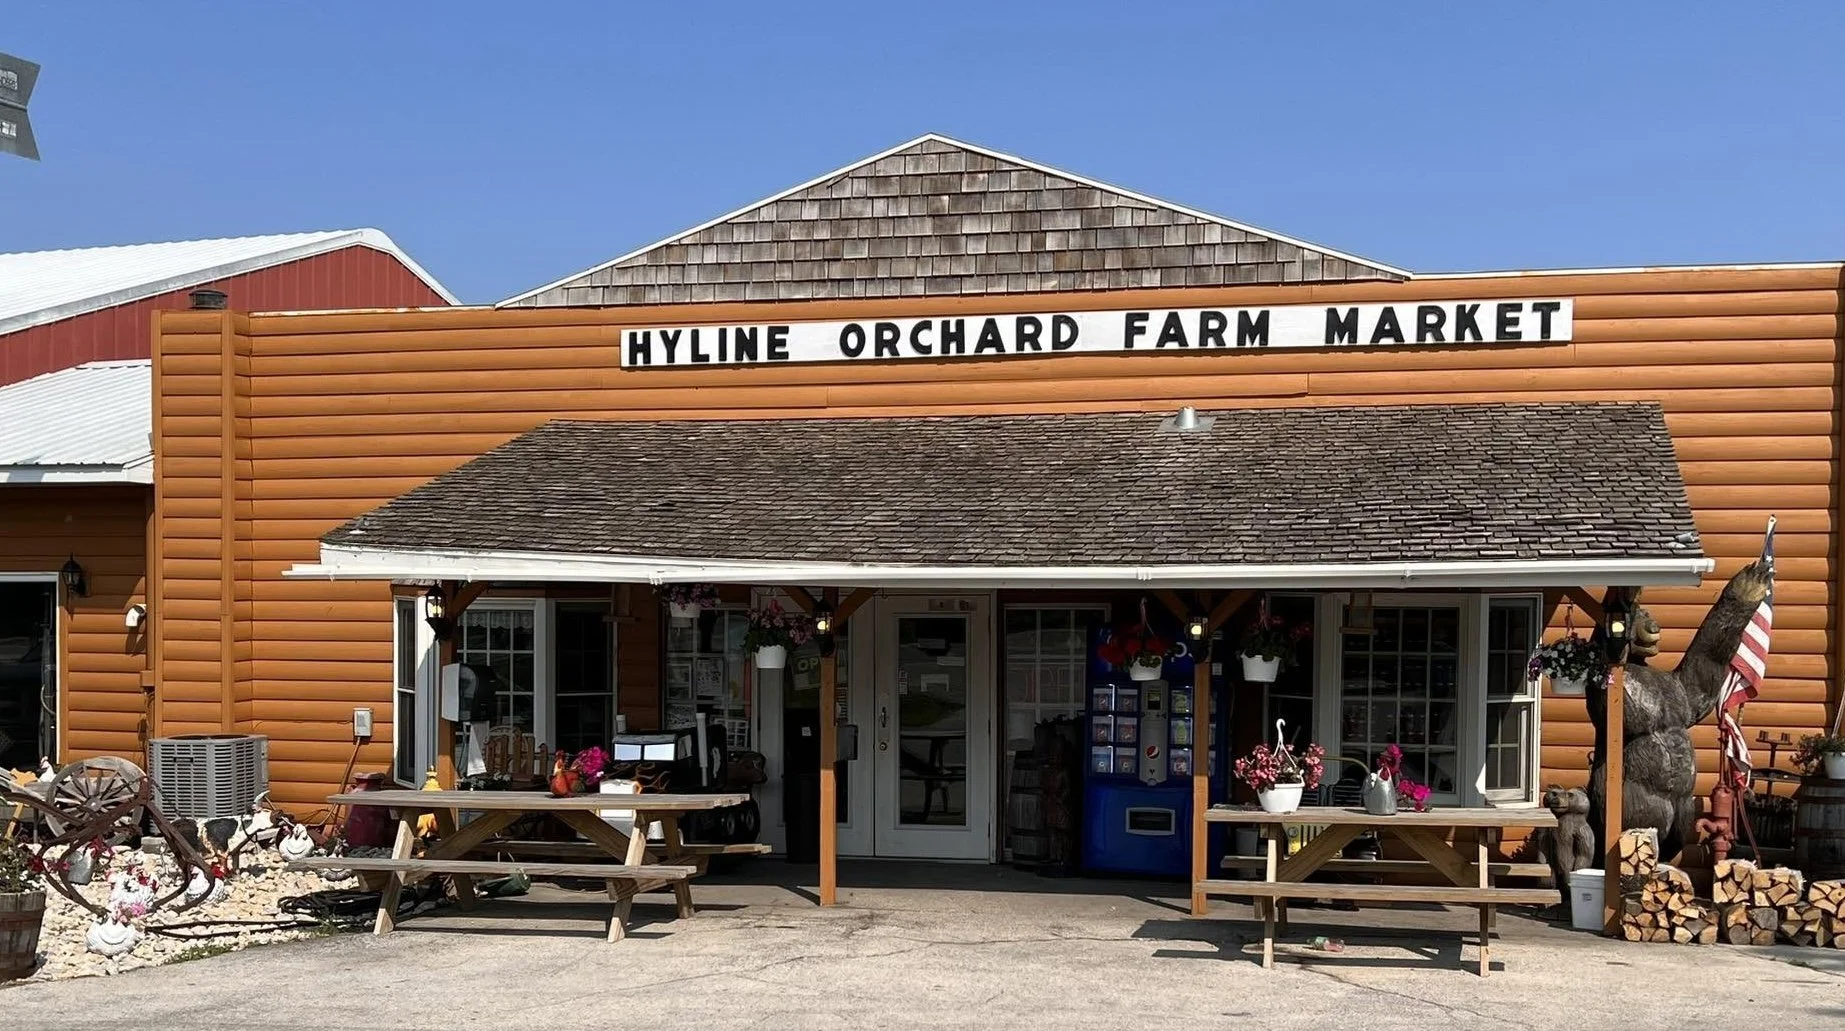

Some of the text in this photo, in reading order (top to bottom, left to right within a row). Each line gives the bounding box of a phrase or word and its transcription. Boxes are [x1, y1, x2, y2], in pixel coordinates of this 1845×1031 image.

[628, 302, 1561, 365] HYLINE ORCHARD FARM MARKET
[797, 657, 819, 672] OP
